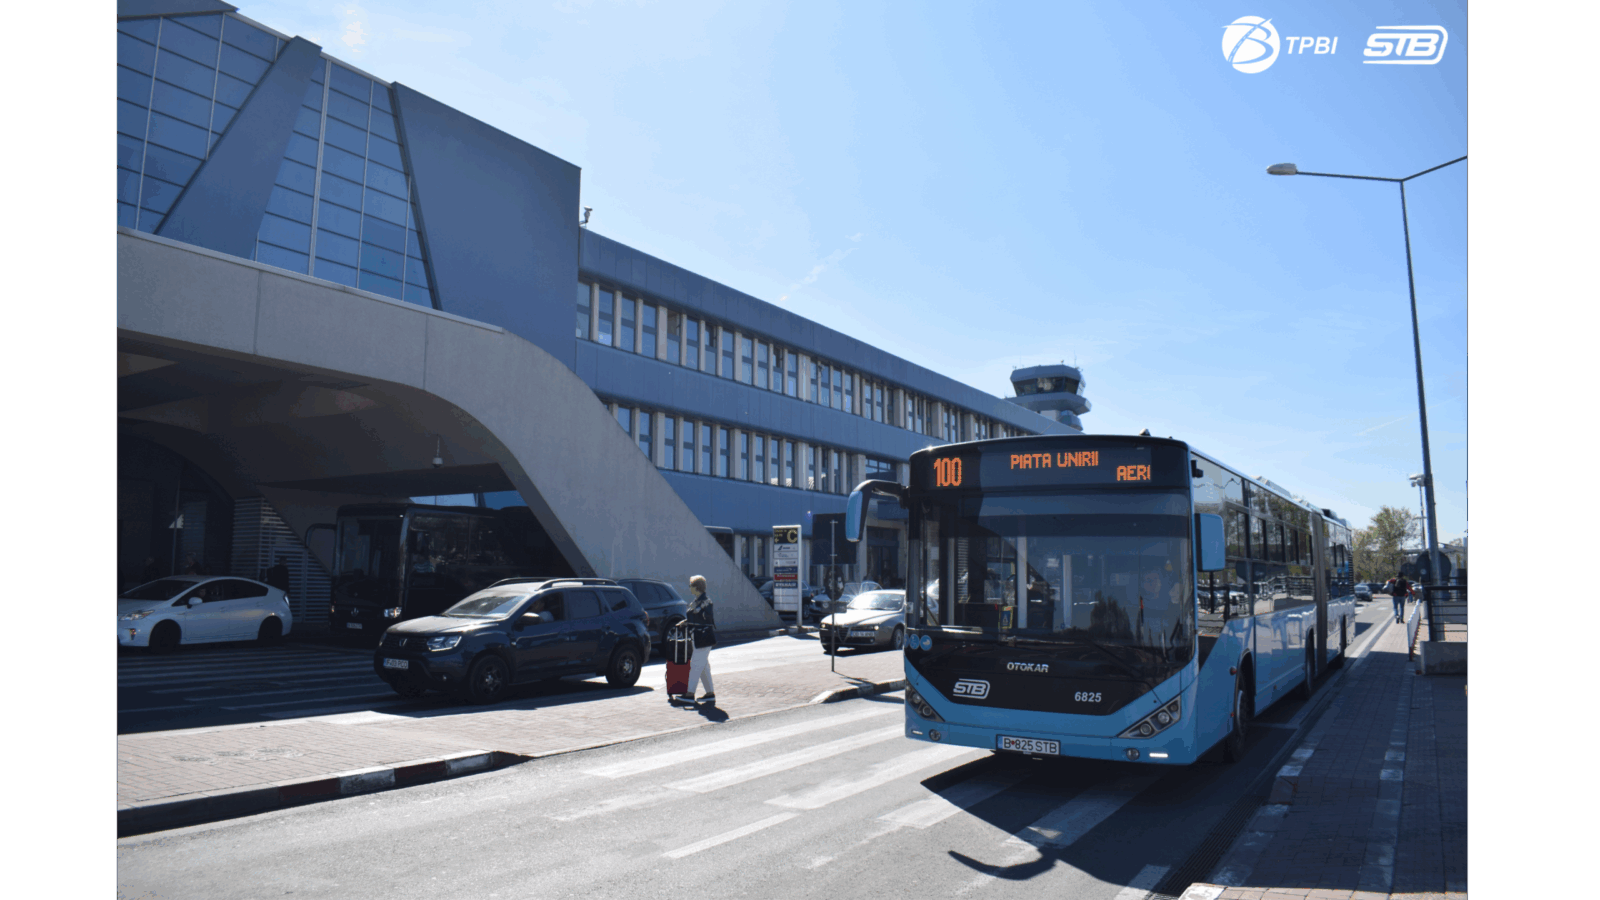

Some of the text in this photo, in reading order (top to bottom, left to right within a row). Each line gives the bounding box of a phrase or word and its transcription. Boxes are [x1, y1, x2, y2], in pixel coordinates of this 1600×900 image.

[1010, 451, 1099, 470] PIATA UNIRII
[933, 457, 963, 487] 100
[787, 529, 798, 543] C
[1007, 662, 1049, 673] OTOKAR
[953, 681, 986, 695] STB
[1074, 691, 1102, 703] 6825
[1003, 737, 1057, 754] B 825 STB
